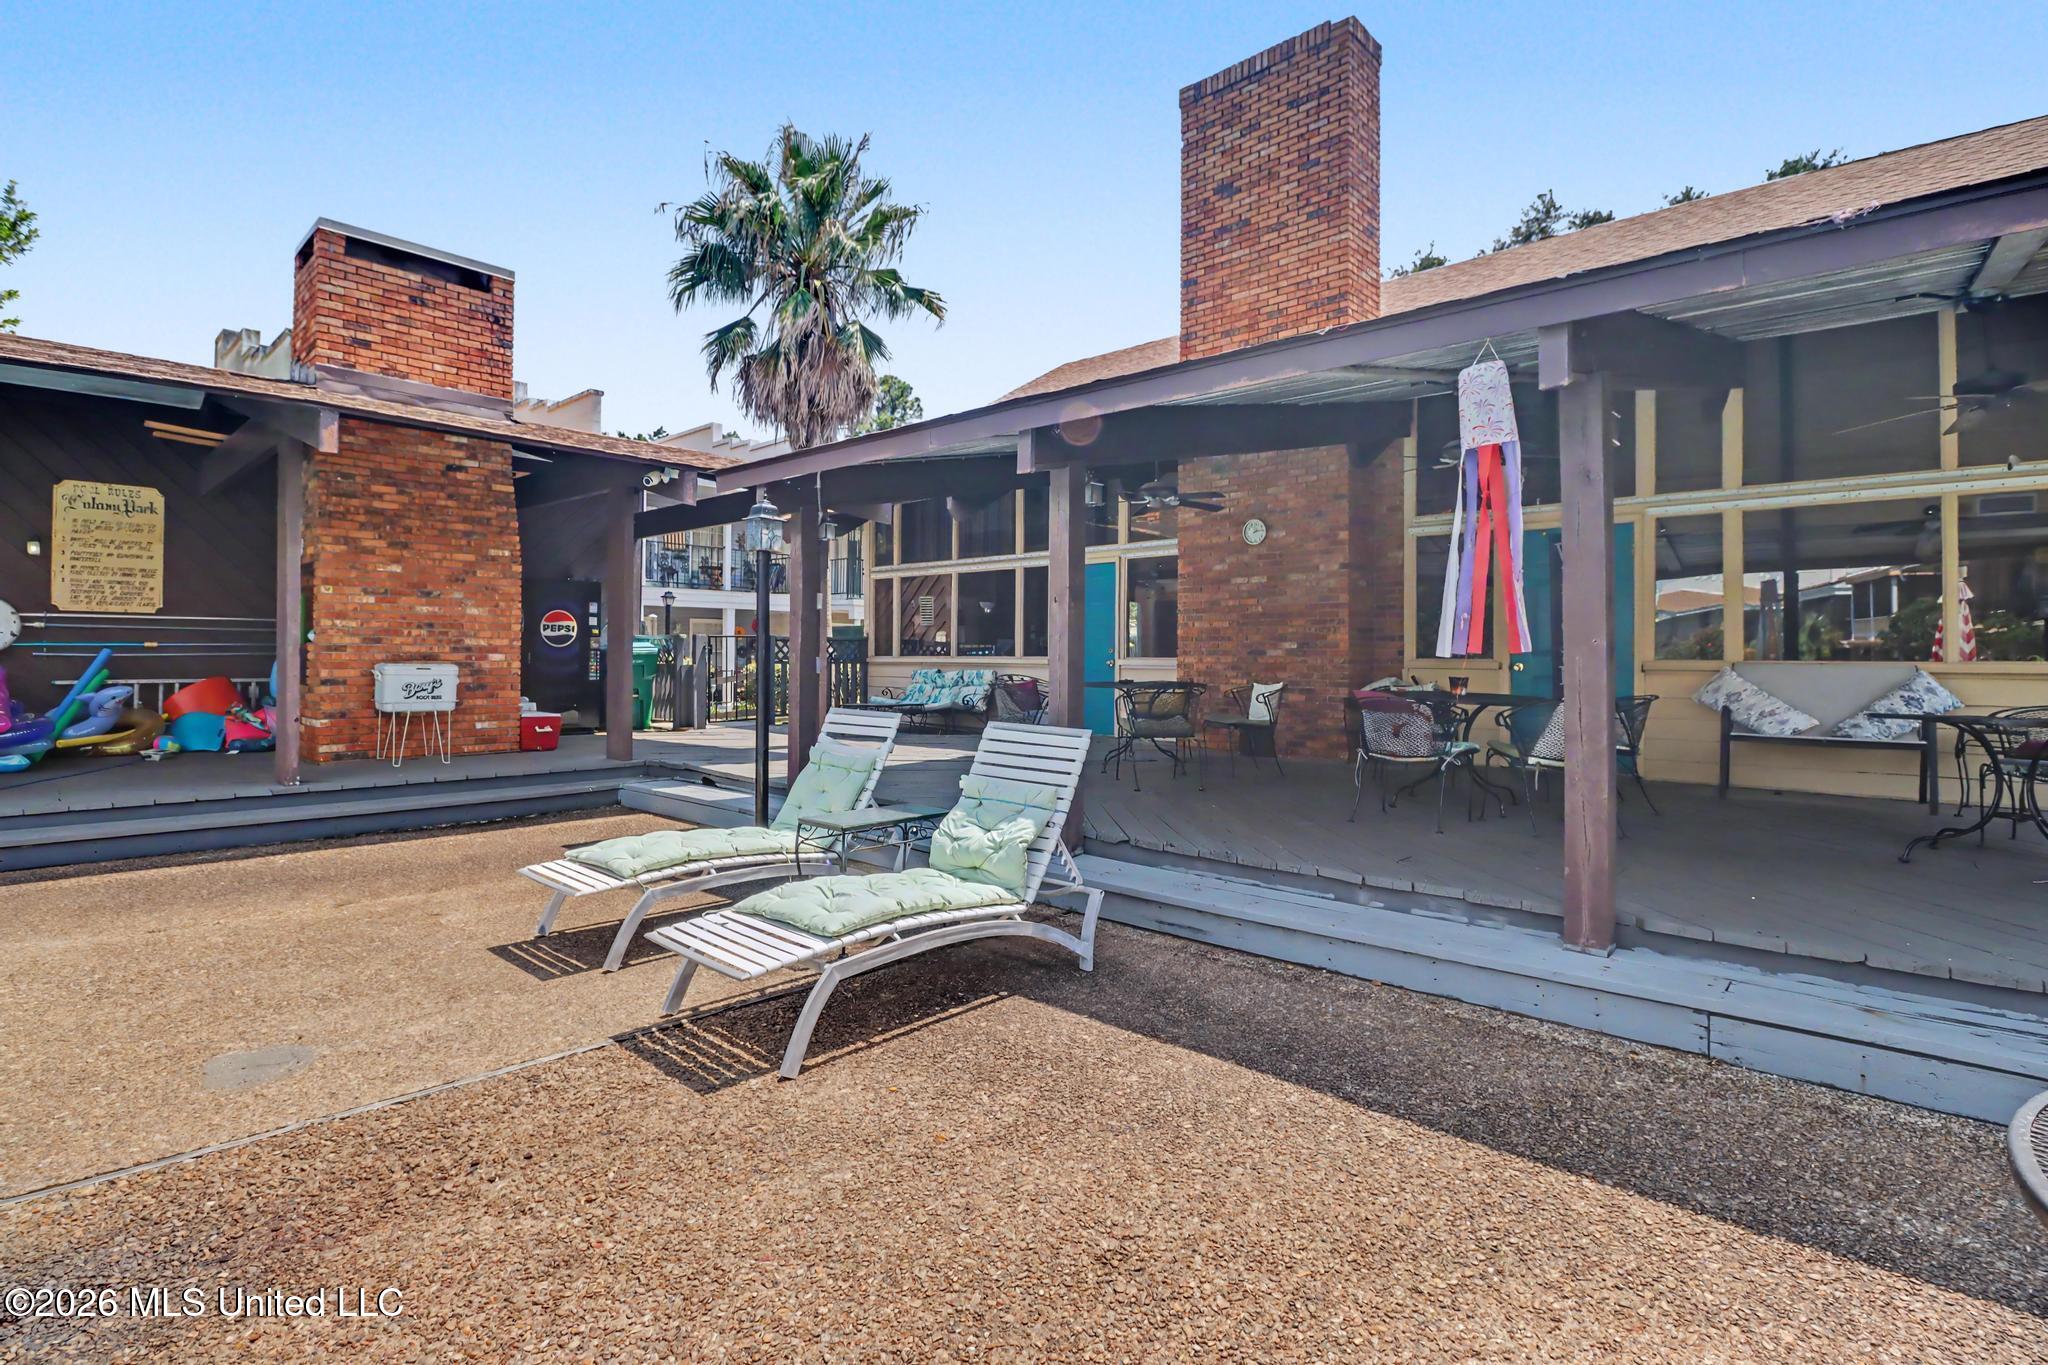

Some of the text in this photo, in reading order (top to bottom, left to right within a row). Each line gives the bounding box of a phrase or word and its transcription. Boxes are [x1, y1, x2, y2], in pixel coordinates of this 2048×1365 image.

[73, 484, 100, 495] POL
[121, 498, 159, 518] Park
[542, 624, 575, 632] PEPSI
